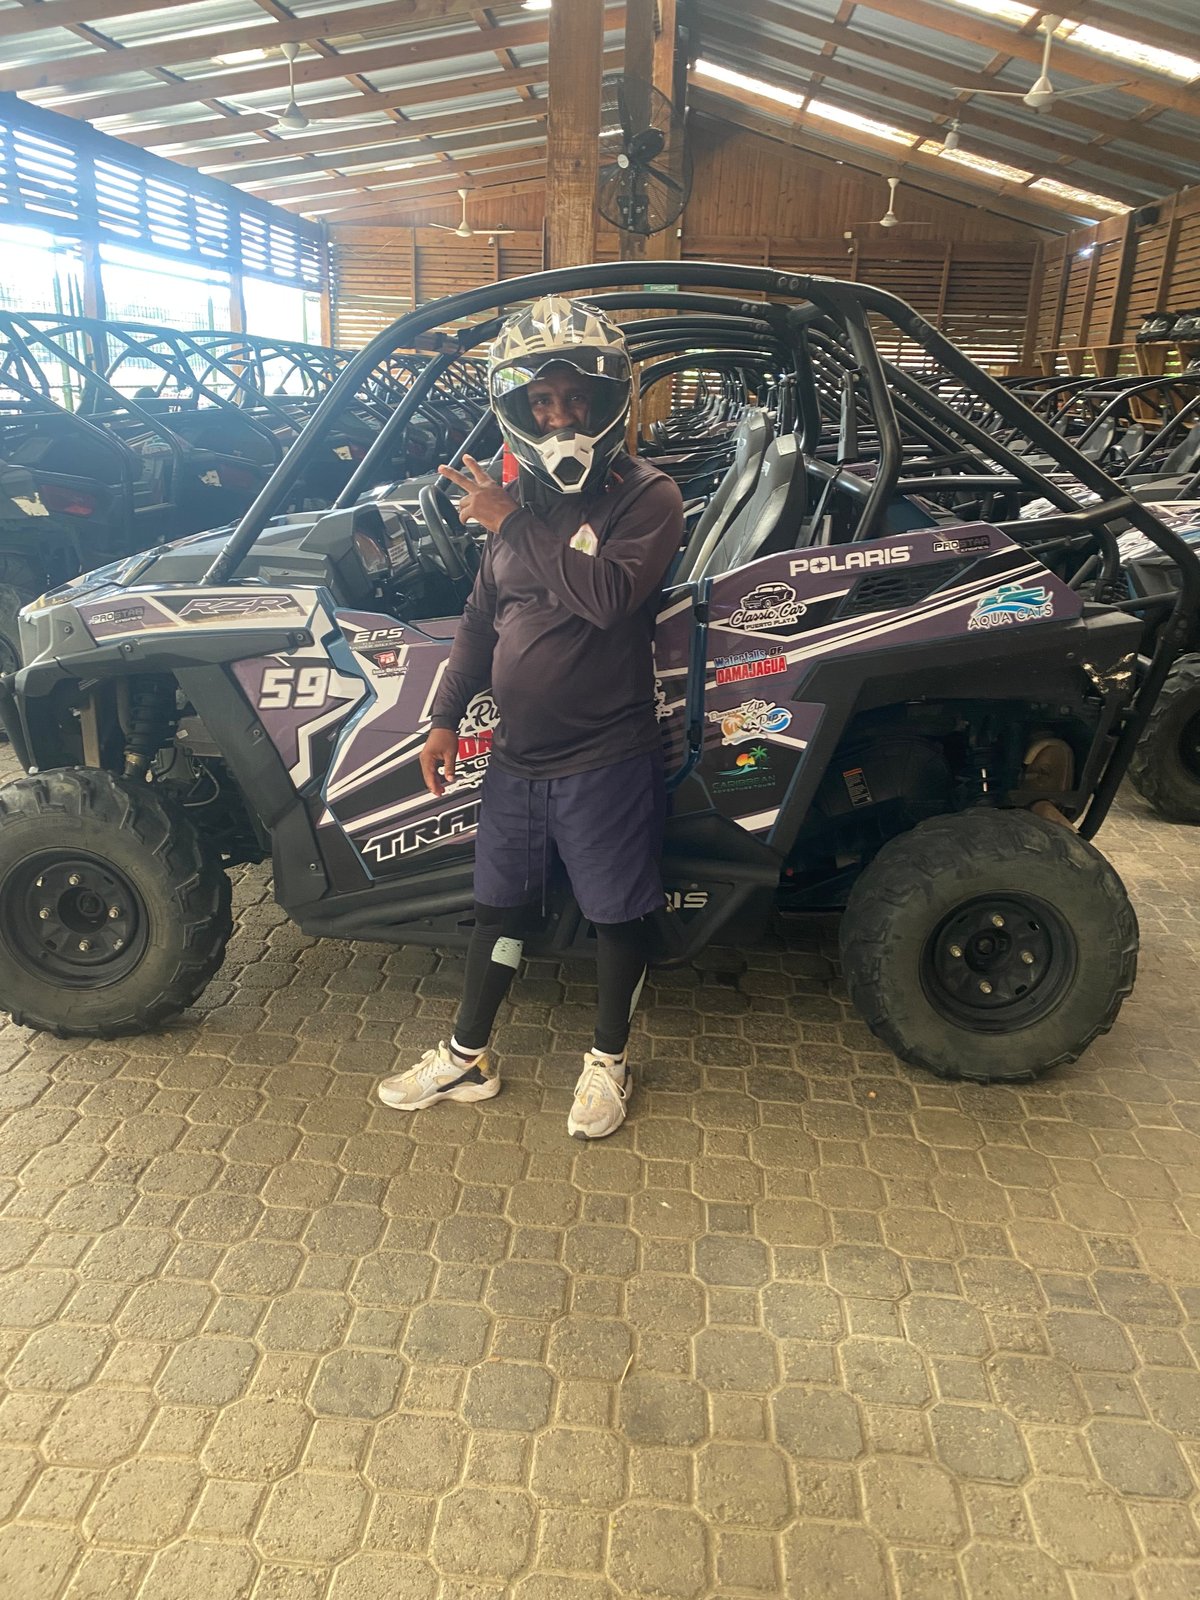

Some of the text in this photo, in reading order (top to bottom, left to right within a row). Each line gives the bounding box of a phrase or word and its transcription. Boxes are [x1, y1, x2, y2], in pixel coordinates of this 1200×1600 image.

[934, 536, 989, 551] PROSTAR
[789, 546, 911, 576] POLARIS
[178, 596, 291, 616] RZR
[731, 603, 806, 626] Classic Car
[746, 617, 796, 630] PUERTO PLATA
[968, 603, 1052, 630] AQUA CATS
[353, 627, 404, 643] EPS
[714, 649, 767, 668] Waterfalls
[716, 656, 787, 685] DAMAJAGUA
[258, 667, 330, 709] 59
[469, 700, 500, 727] Ru
[742, 701, 765, 713] Zip
[756, 713, 780, 725] Dip
[712, 775, 776, 789] CARIBBEAN
